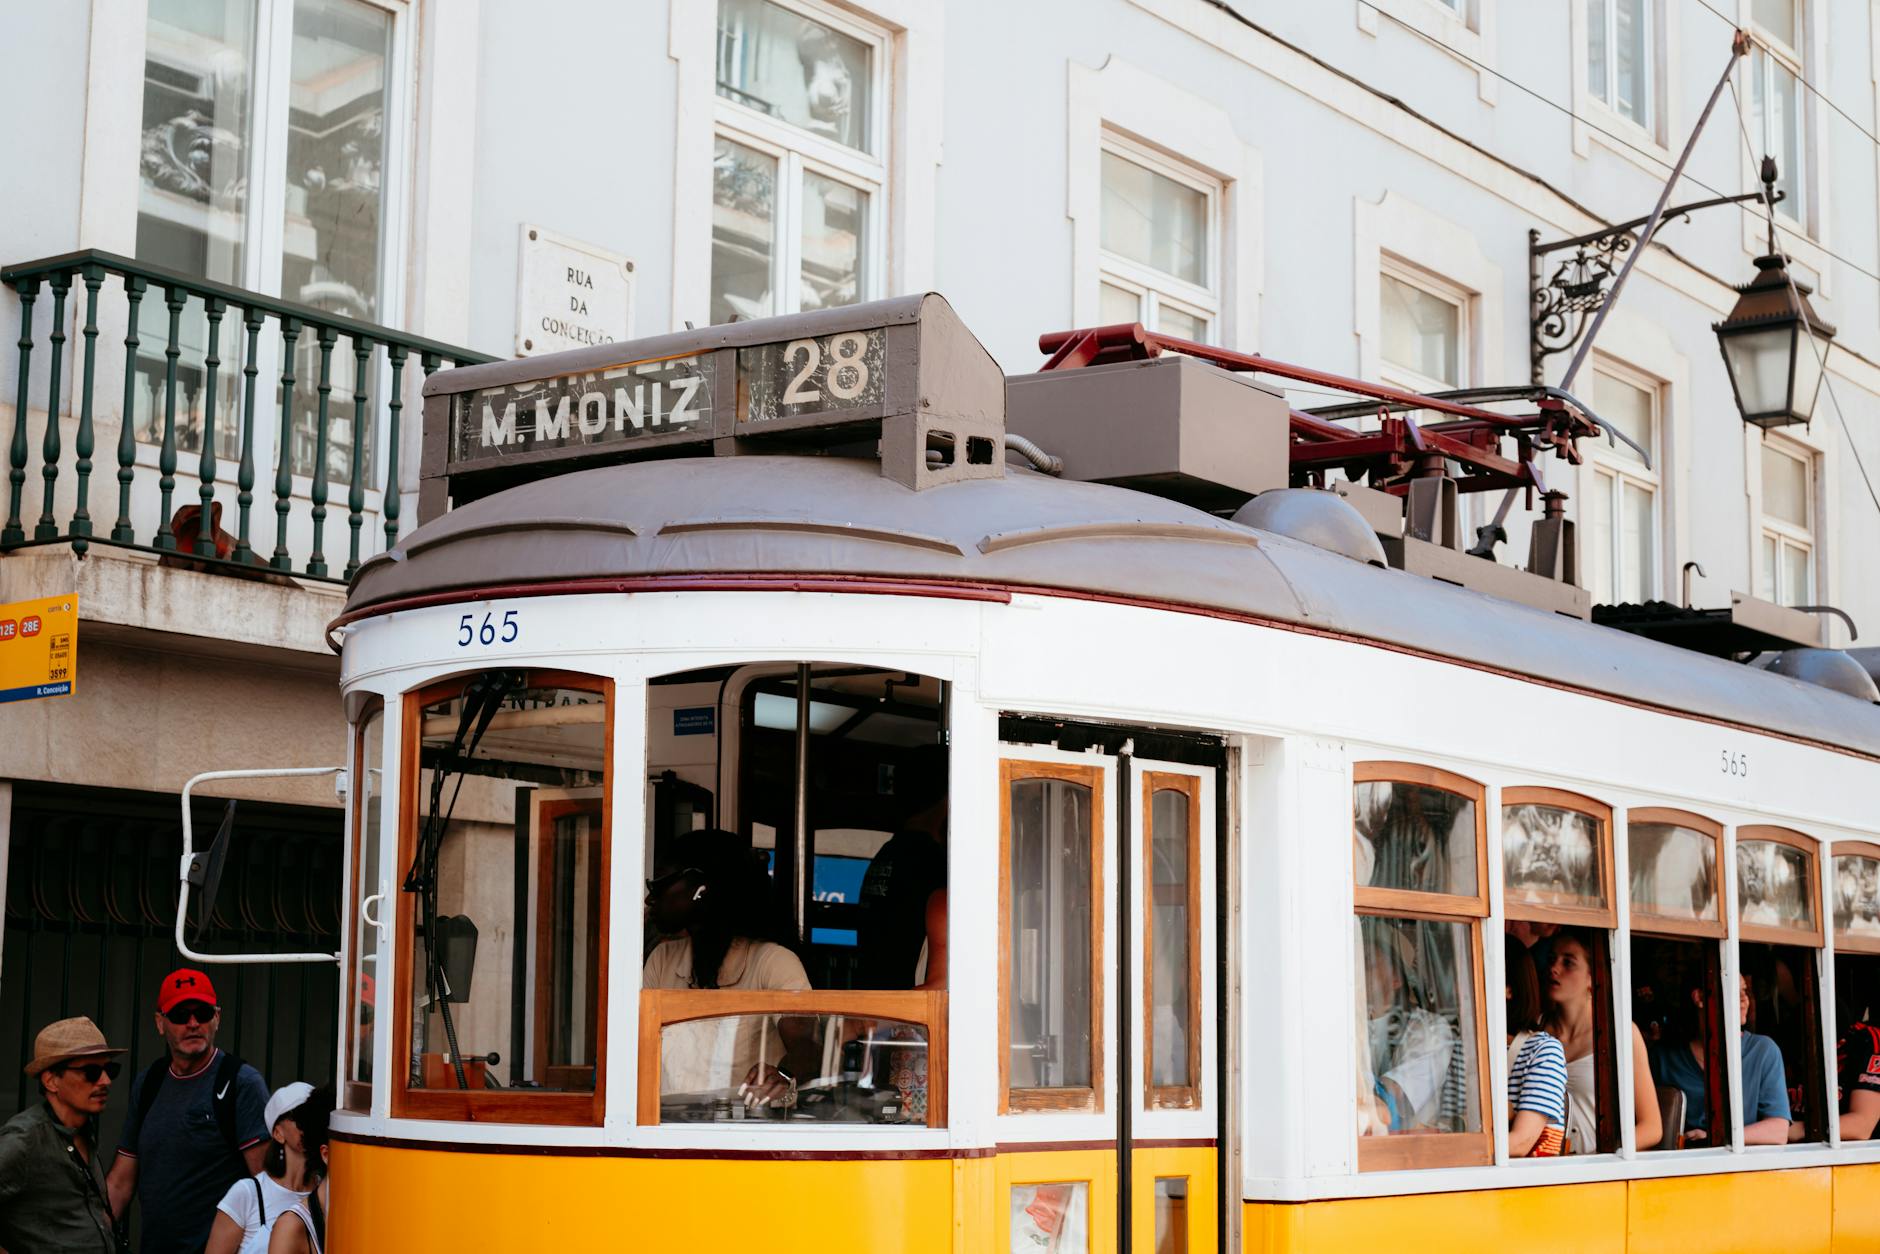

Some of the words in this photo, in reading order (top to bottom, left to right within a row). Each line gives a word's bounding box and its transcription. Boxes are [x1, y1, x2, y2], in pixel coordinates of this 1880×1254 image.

[567, 266, 593, 290] RUA
[570, 295, 588, 316] DA
[782, 331, 869, 400] 28
[0, 623, 15, 637] 12E
[22, 620, 39, 633] 28E
[458, 610, 518, 647] 565
[50, 668, 67, 679] 3599
[1721, 749, 1748, 777] 565
